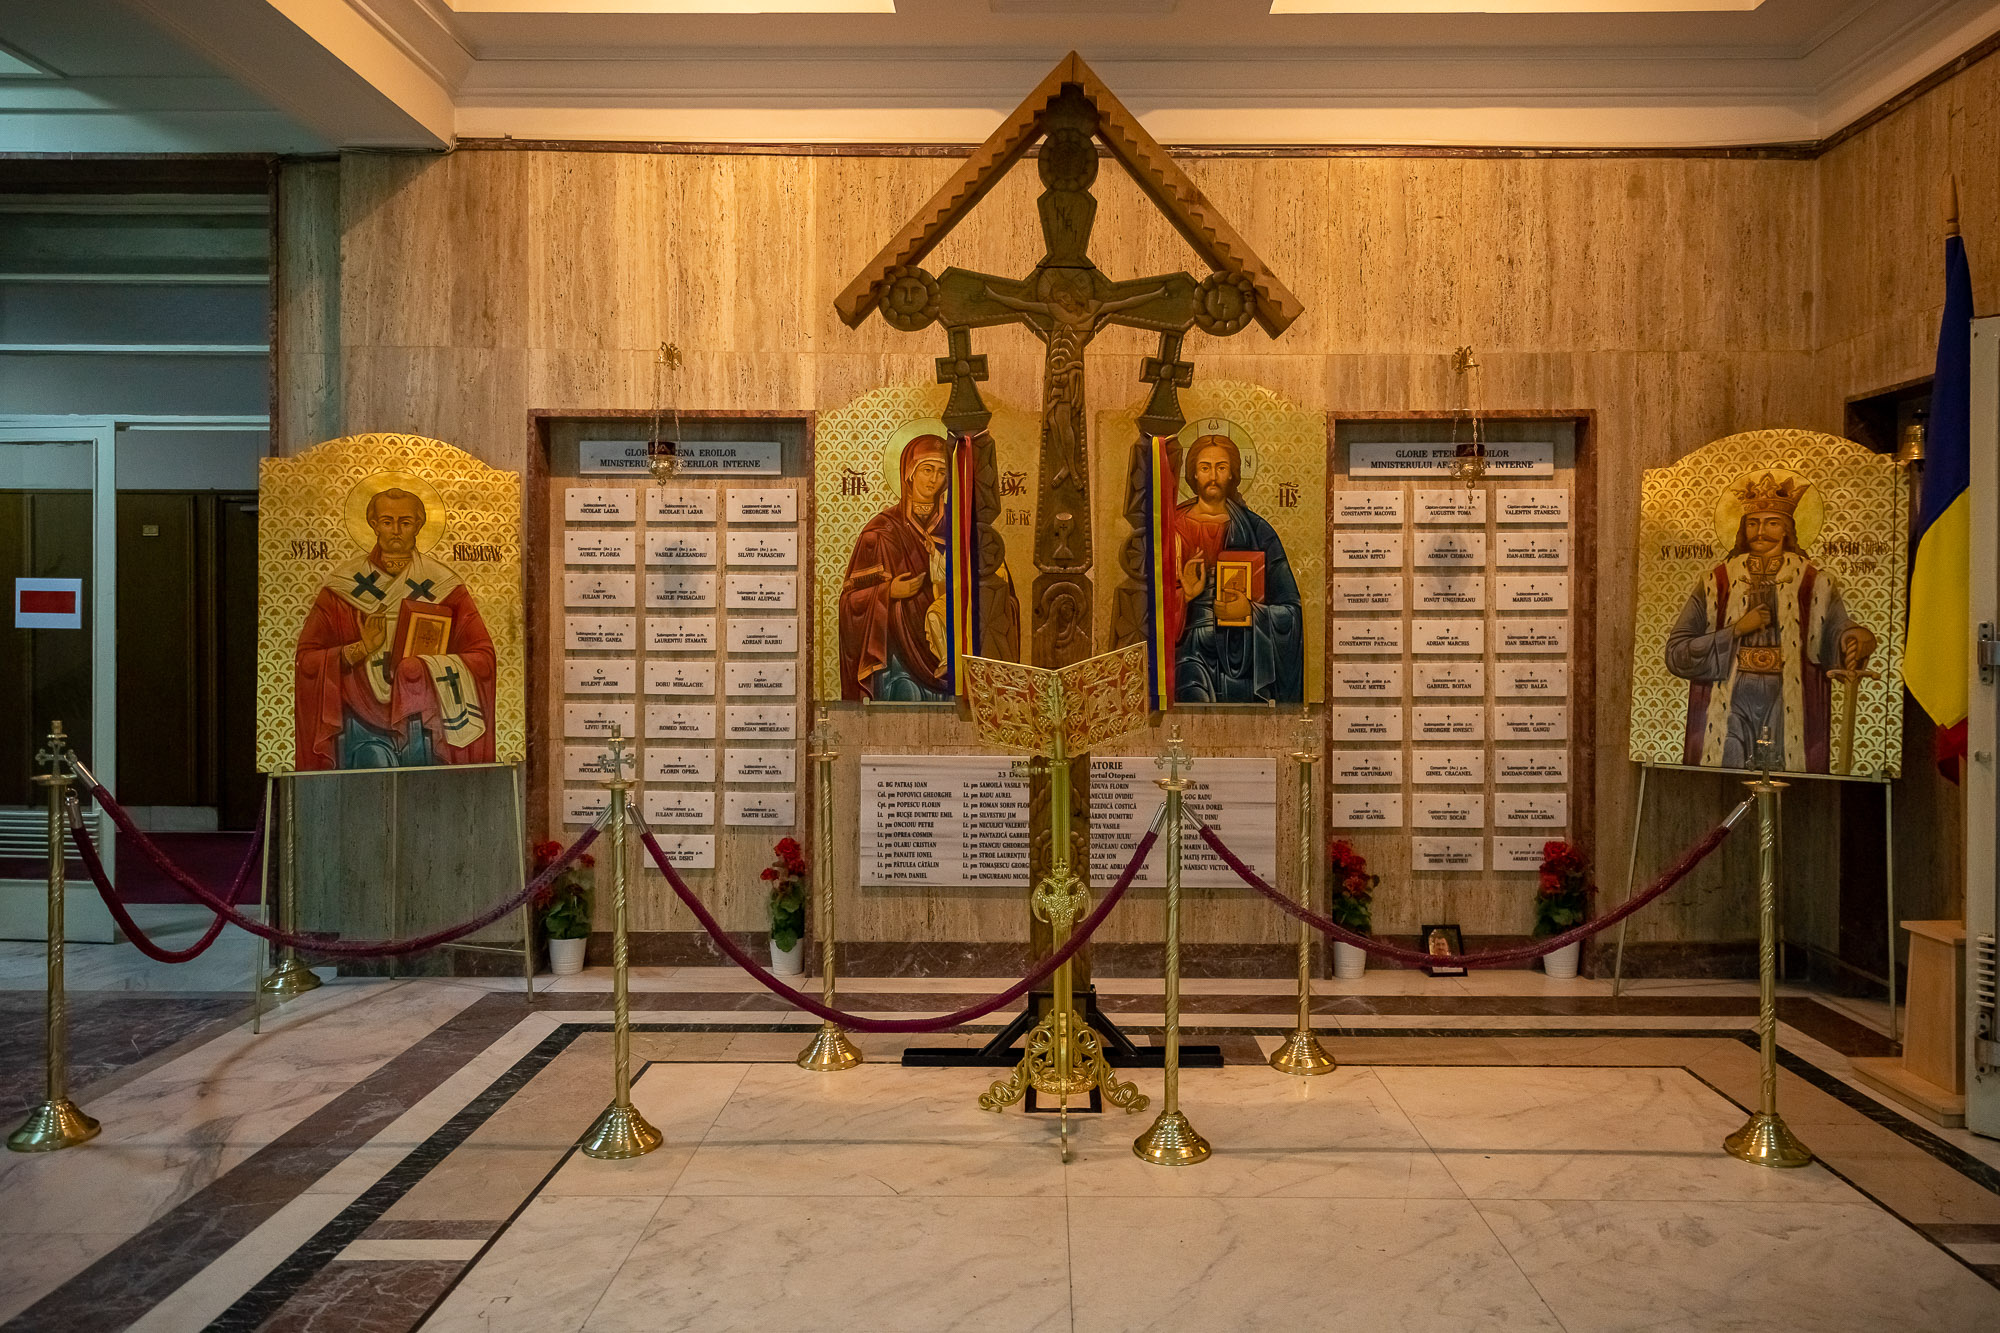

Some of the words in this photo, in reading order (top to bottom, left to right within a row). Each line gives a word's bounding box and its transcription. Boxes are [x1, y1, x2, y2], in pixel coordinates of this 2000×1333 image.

[699, 449, 736, 457] EROILOR
[1396, 450, 1428, 458] GLORIE
[600, 460, 648, 468] MINISTERU
[1090, 762, 1123, 770] ATORIE
[1108, 772, 1136, 780] Otopeni
